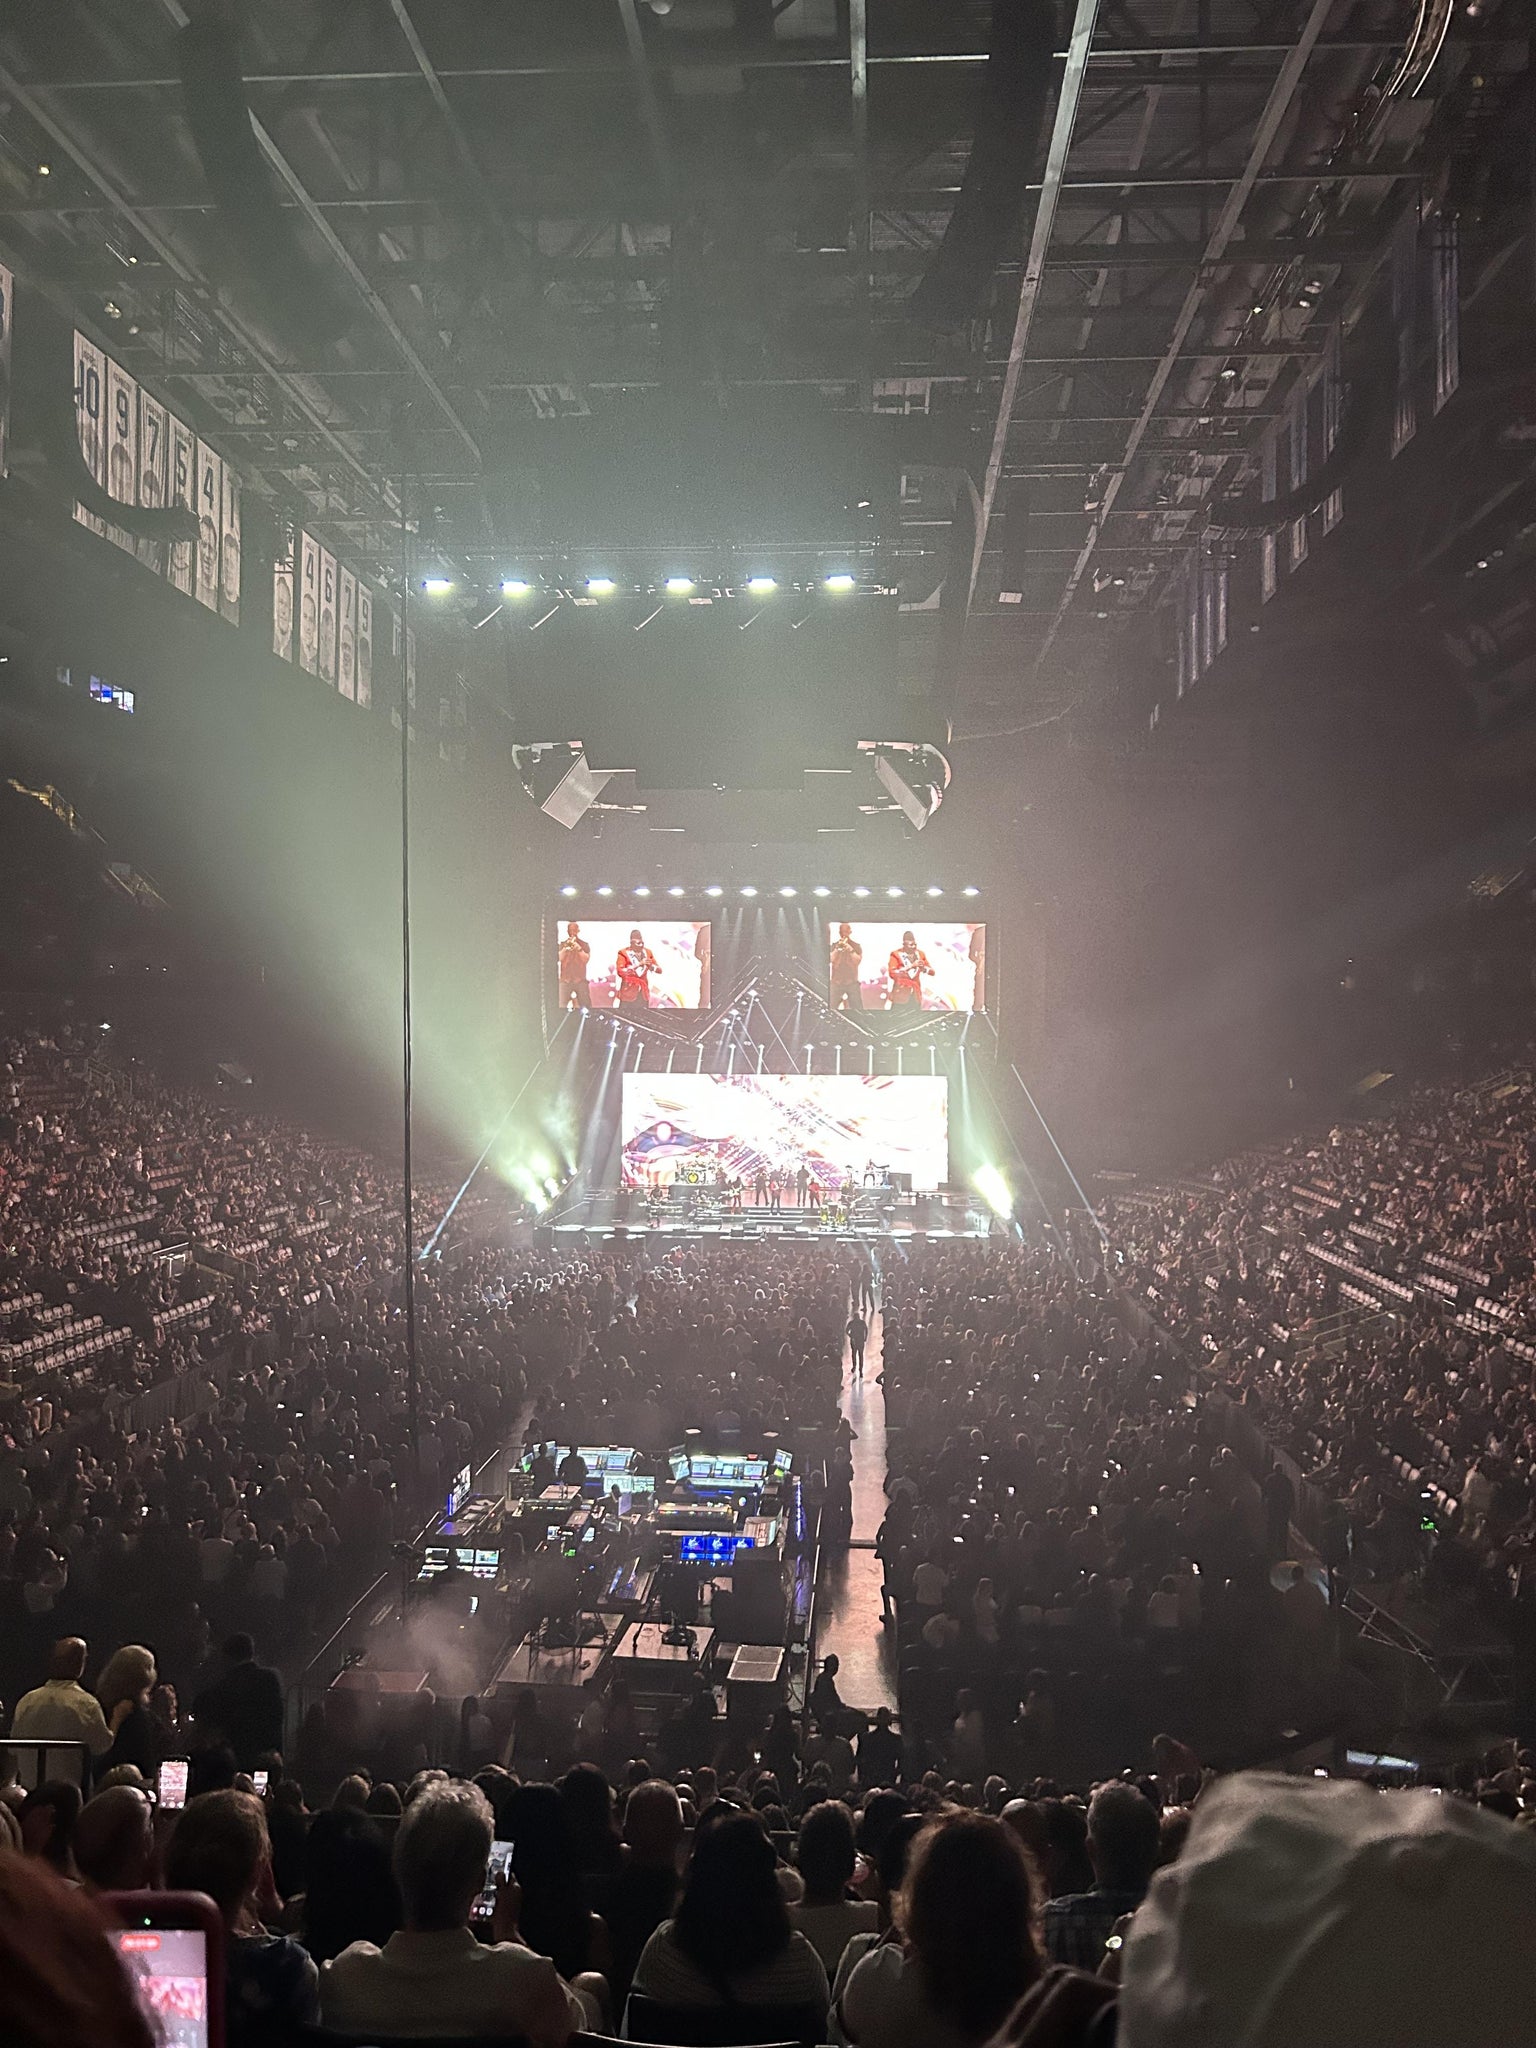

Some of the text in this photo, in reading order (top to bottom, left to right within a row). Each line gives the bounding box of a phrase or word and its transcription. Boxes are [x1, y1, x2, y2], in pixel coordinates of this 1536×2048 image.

[79, 358, 99, 420] 10
[116, 385, 128, 439] 9
[148, 414, 159, 462] 7
[177, 439, 187, 487] 5
[204, 466, 214, 510] 4
[306, 552, 314, 590] 4
[325, 567, 333, 604] 6
[345, 584, 352, 618] 7
[362, 598, 369, 633] 9
